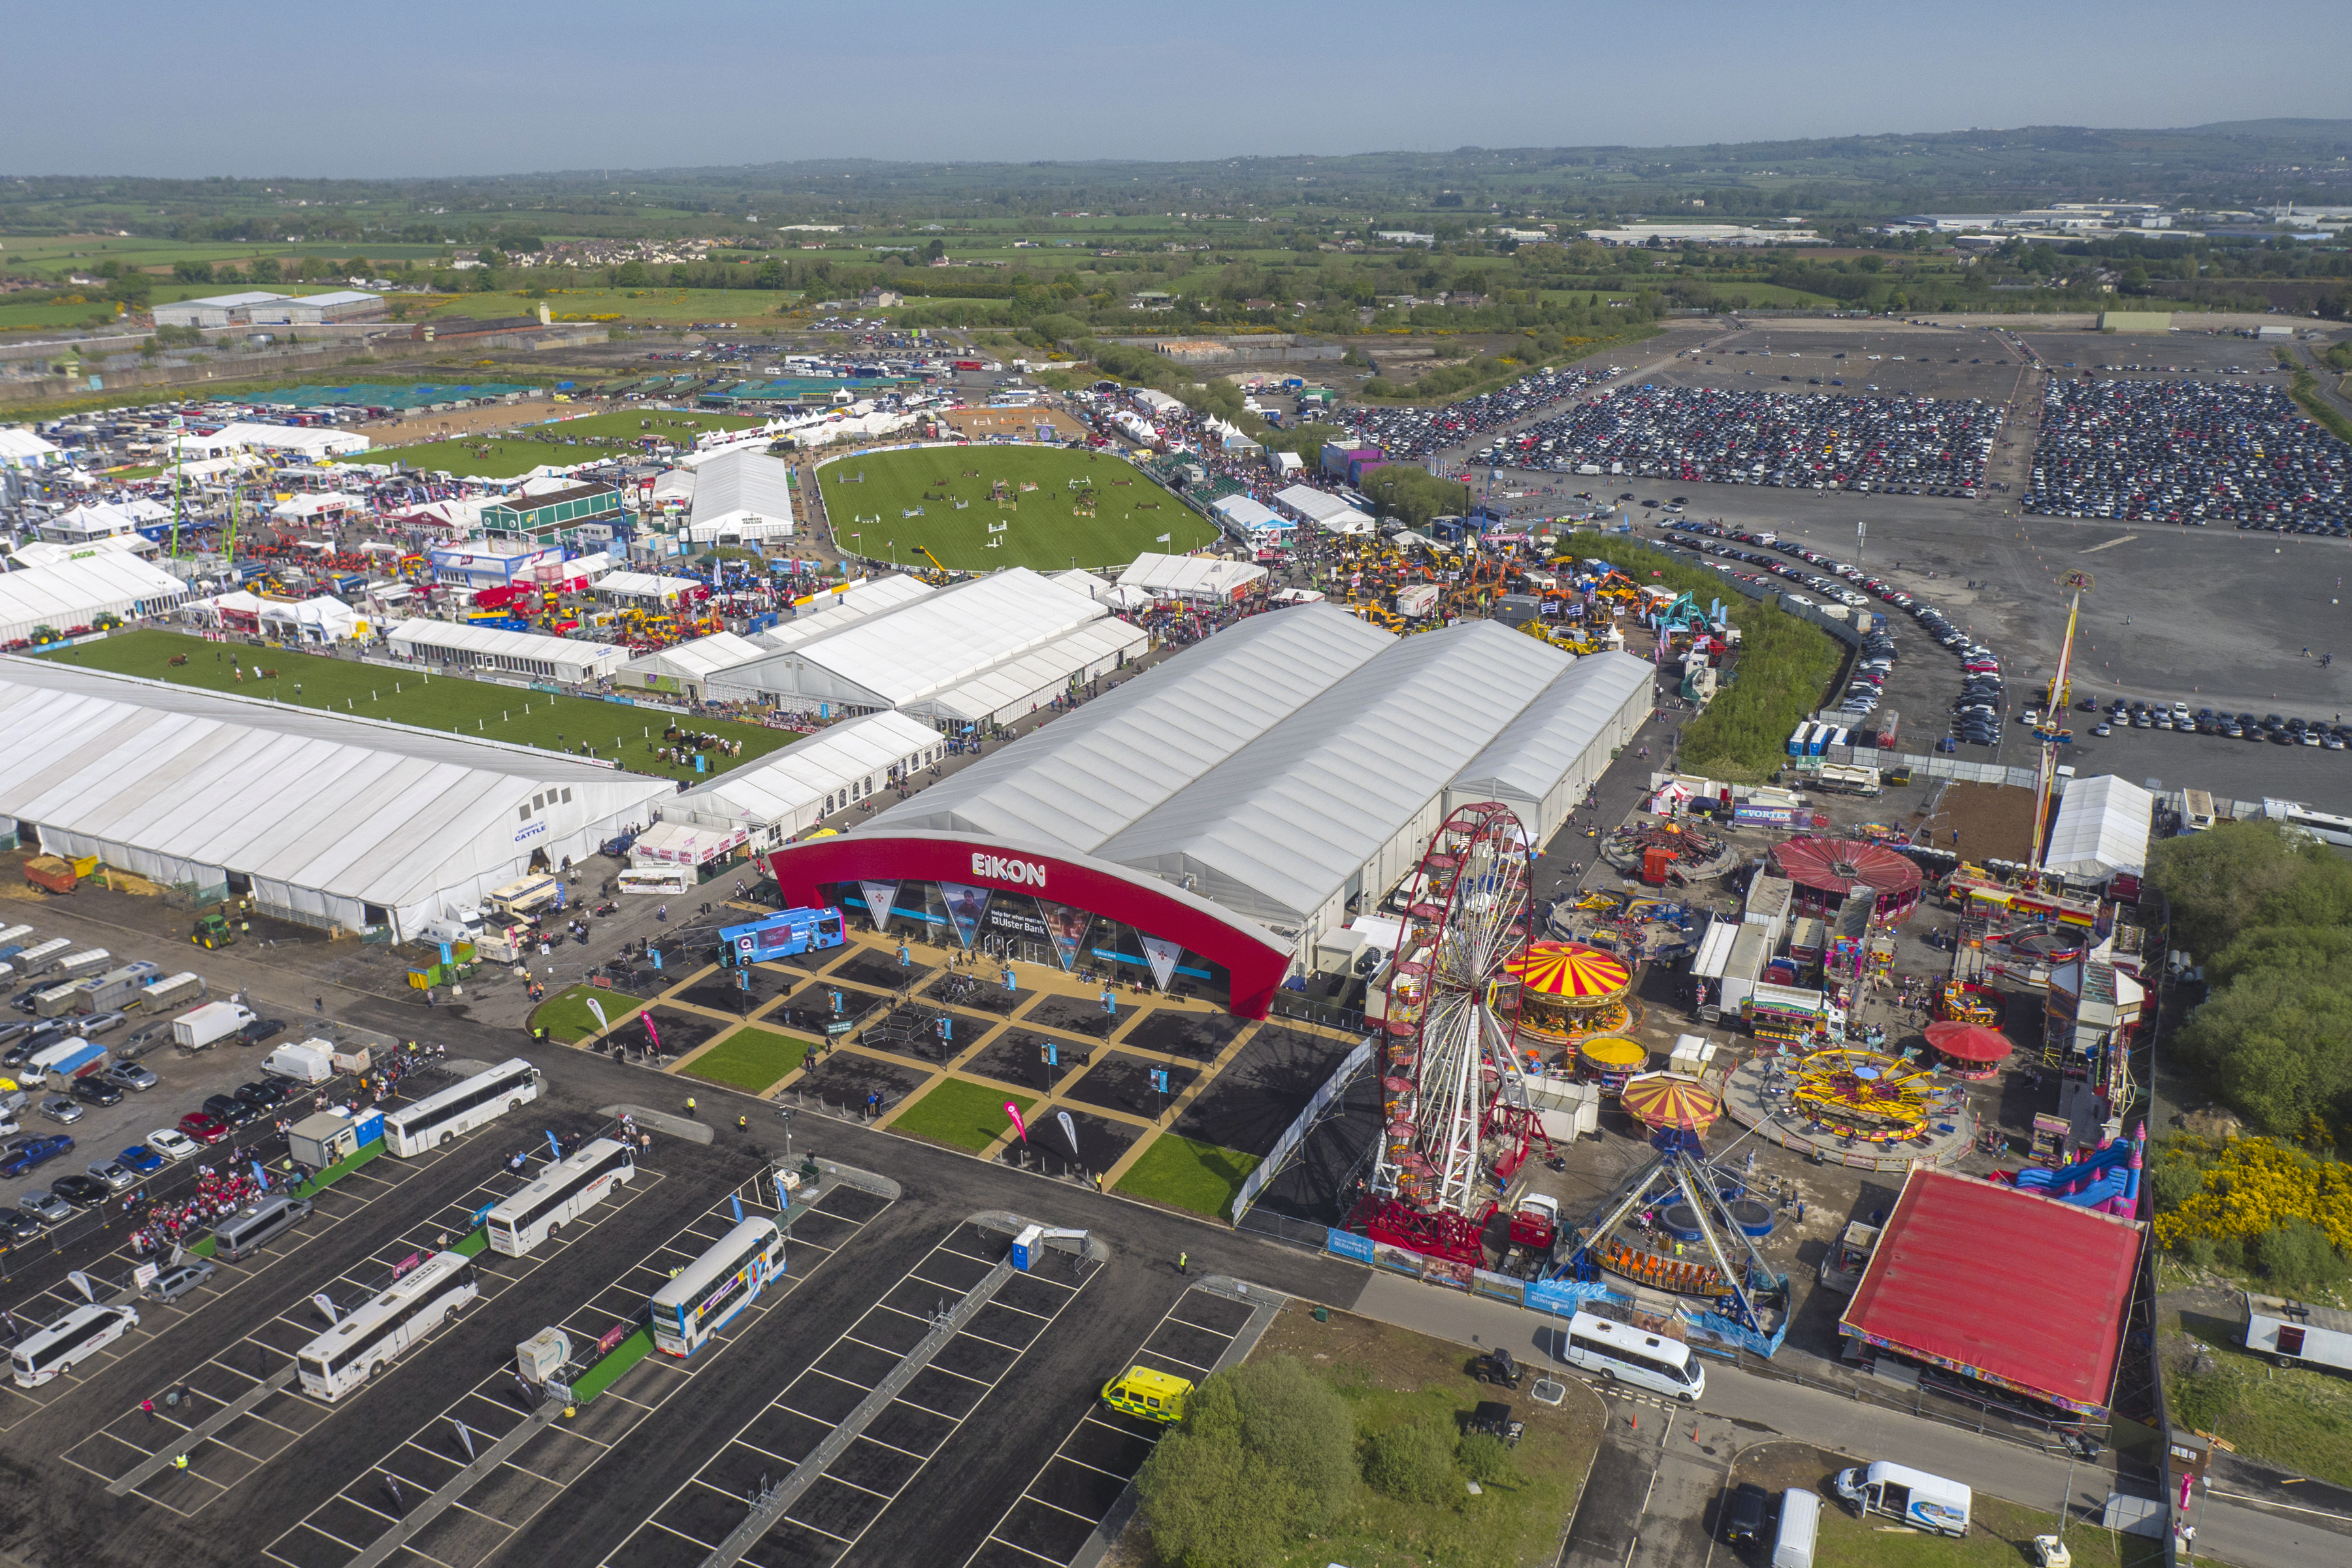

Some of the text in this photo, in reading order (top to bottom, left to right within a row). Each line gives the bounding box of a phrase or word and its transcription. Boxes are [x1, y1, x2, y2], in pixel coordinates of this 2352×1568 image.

[323, 502, 346, 511] SPAR
[71, 550, 97, 560] ASDA
[769, 721, 791, 730] dunbia
[1748, 810, 1791, 819] VORTEX
[515, 825, 546, 841] CATTLE
[518, 823, 538, 834] ENTRANCE
[735, 830, 746, 839] FARM
[736, 835, 747, 843] WEEK
[719, 838, 730, 848] FARM
[719, 843, 730, 852] WEEK
[702, 847, 714, 857] FARM
[702, 853, 715, 861] WEEK
[1012, 913, 1024, 921] what
[1024, 915, 1045, 925] matters
[999, 916, 1045, 934] Ulster Bank
[587, 1175, 608, 1192] HOLMES
[1339, 1241, 1367, 1255] Ulster Bank
[1624, 1364, 1641, 1373] Coaches
